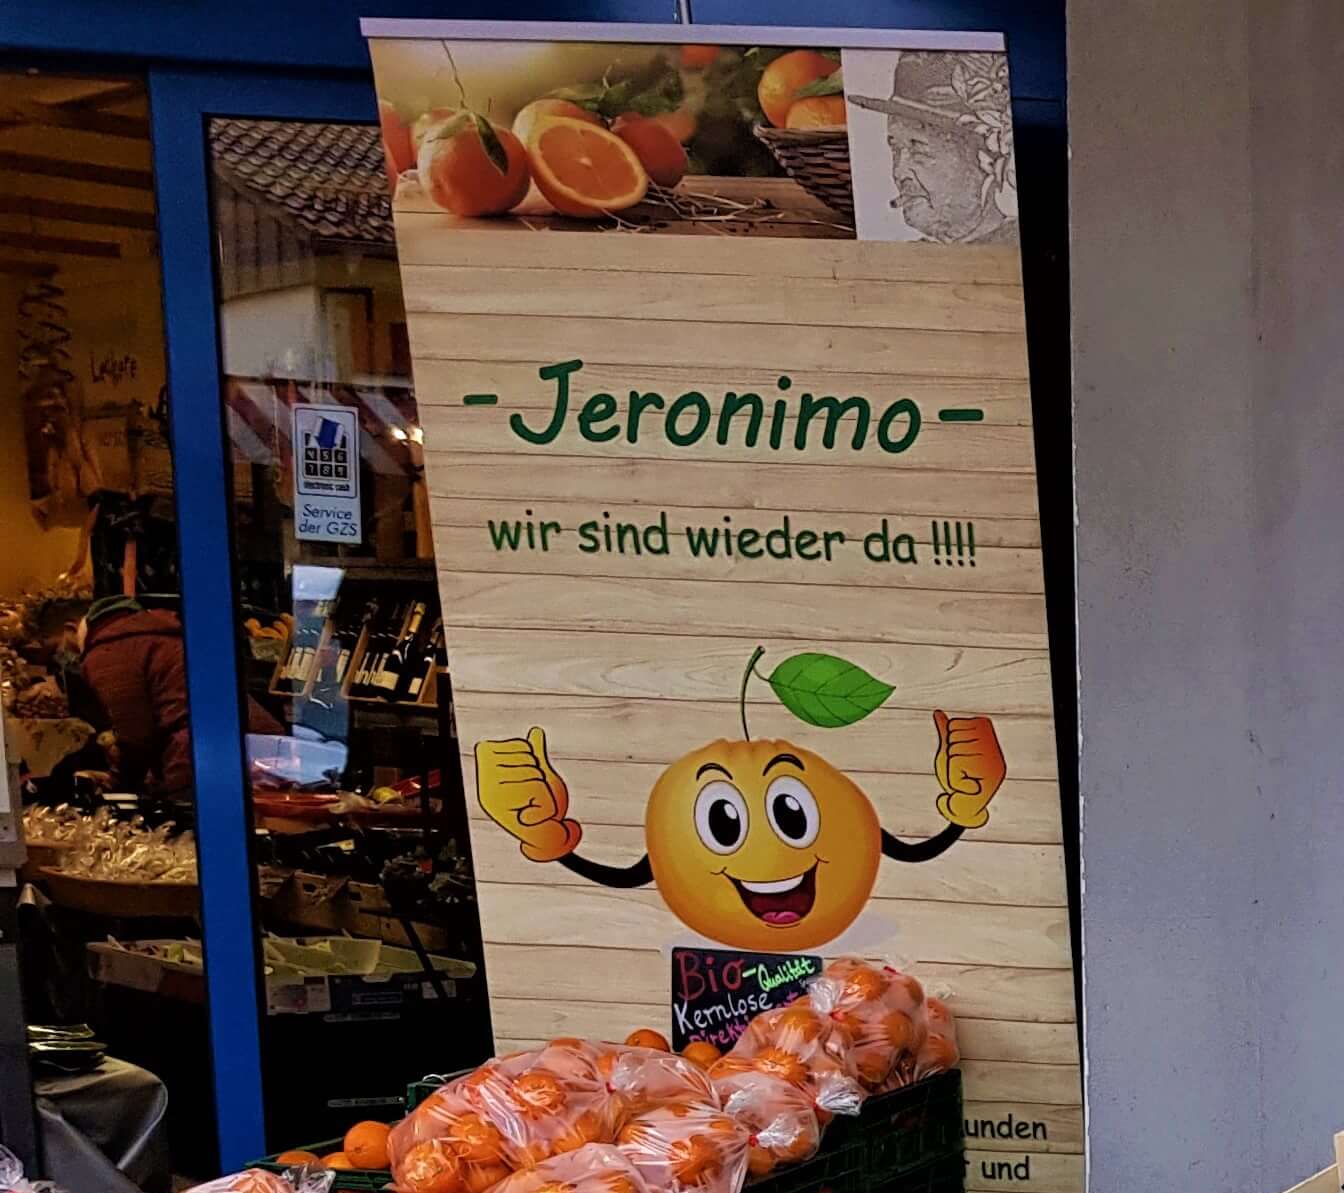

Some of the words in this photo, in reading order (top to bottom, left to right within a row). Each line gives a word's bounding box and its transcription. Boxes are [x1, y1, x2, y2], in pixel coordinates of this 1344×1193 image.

[303, 503, 353, 520] Service
[299, 519, 320, 534] der
[326, 521, 358, 537] GZS
[488, 509, 561, 552] wir
[578, 512, 670, 556] sind
[686, 515, 845, 561] wieder
[864, 519, 918, 565] da
[673, 993, 773, 1035] Kernlose
[963, 1113, 1048, 1140] unden
[981, 1155, 1030, 1180] und
